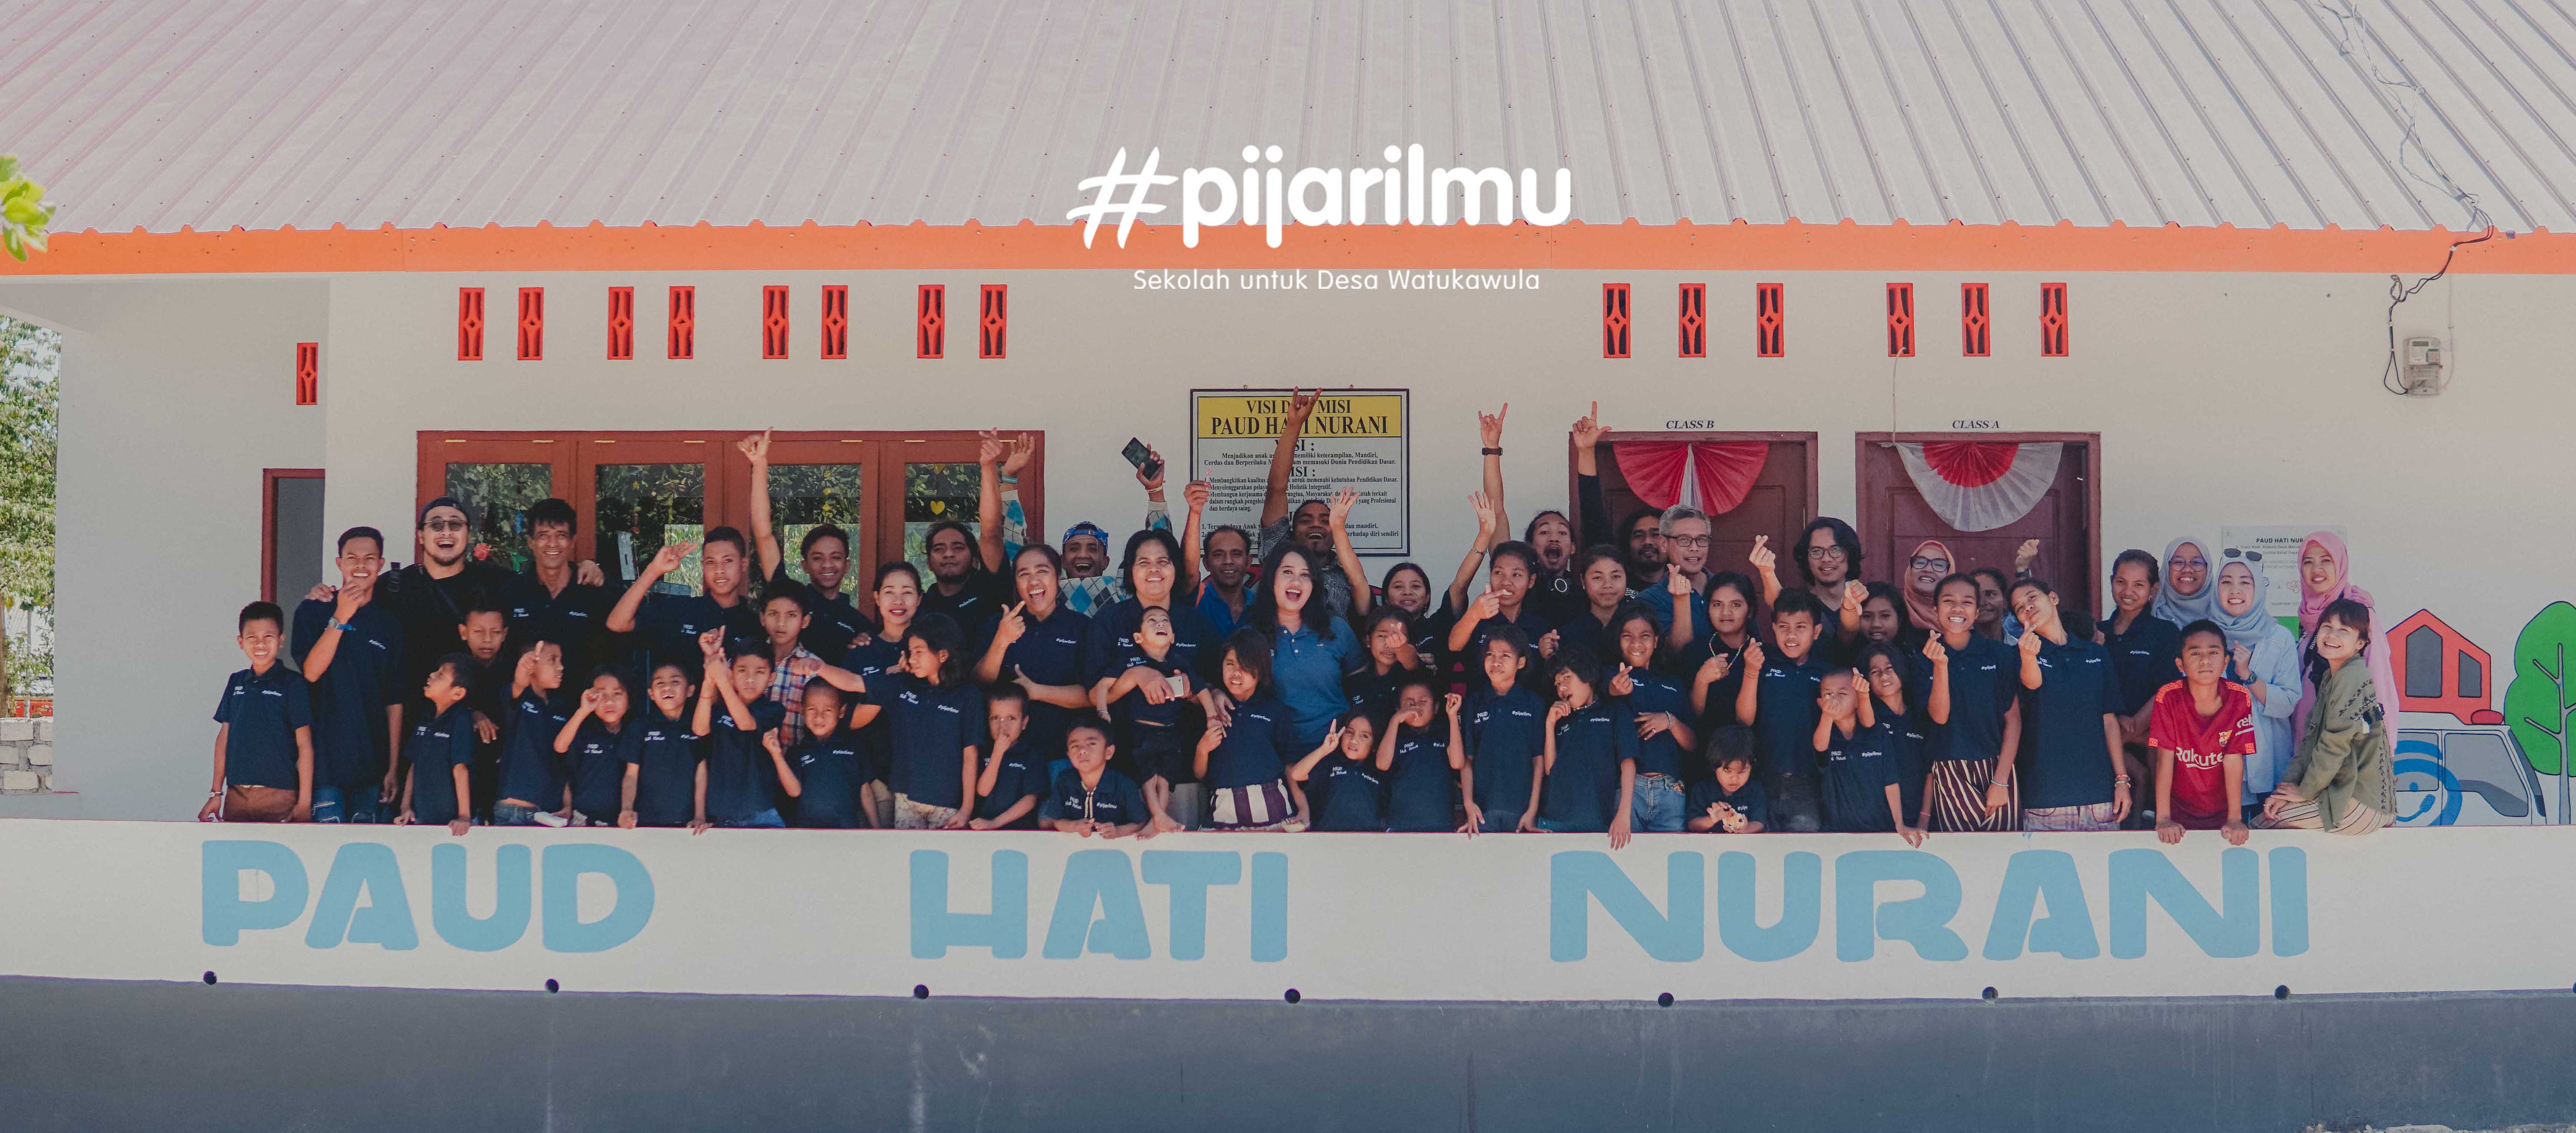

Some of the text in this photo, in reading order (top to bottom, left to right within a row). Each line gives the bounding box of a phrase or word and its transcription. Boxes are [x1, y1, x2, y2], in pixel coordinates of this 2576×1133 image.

[1247, 400, 1276, 413] VISI
[1318, 400, 1351, 413] MISI
[1211, 416, 1389, 434] PAUD HAI NURANI
[1666, 420, 1714, 429] CLASS B
[1952, 420, 1999, 429] CLASS A
[1291, 466, 1308, 477] ISI
[2176, 747, 2224, 766] Rakute
[201, 840, 2309, 963] PAUD HATI NURANI
